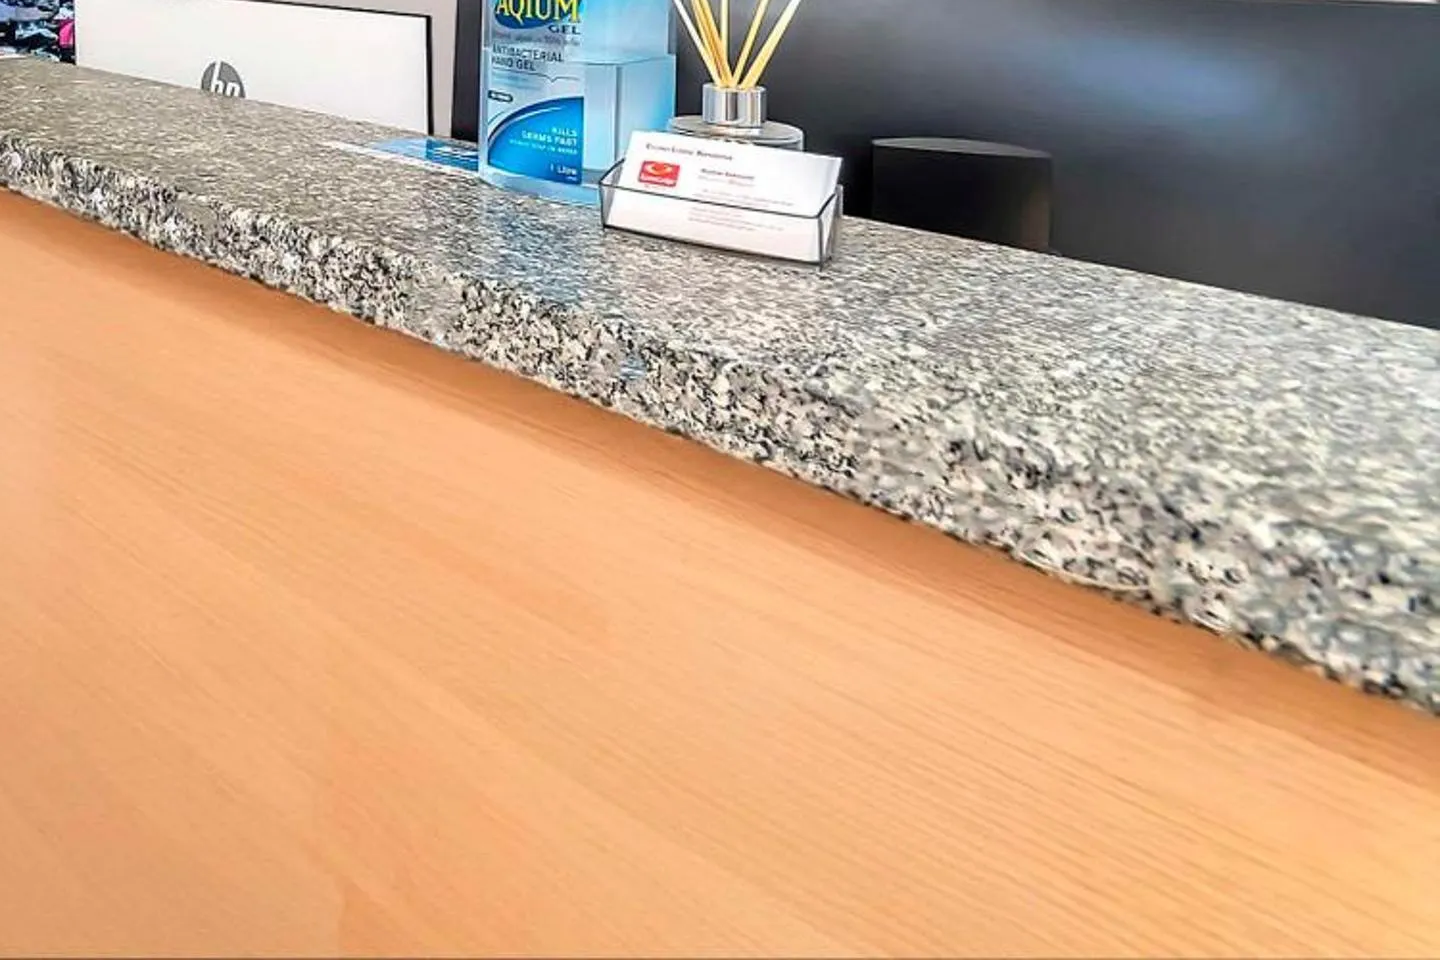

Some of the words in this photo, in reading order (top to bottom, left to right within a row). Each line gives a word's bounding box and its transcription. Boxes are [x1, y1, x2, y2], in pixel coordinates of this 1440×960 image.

[548, 24, 581, 35] GEL
[492, 42, 564, 63] ANTIBACTERIAL
[516, 59, 537, 71] GEL
